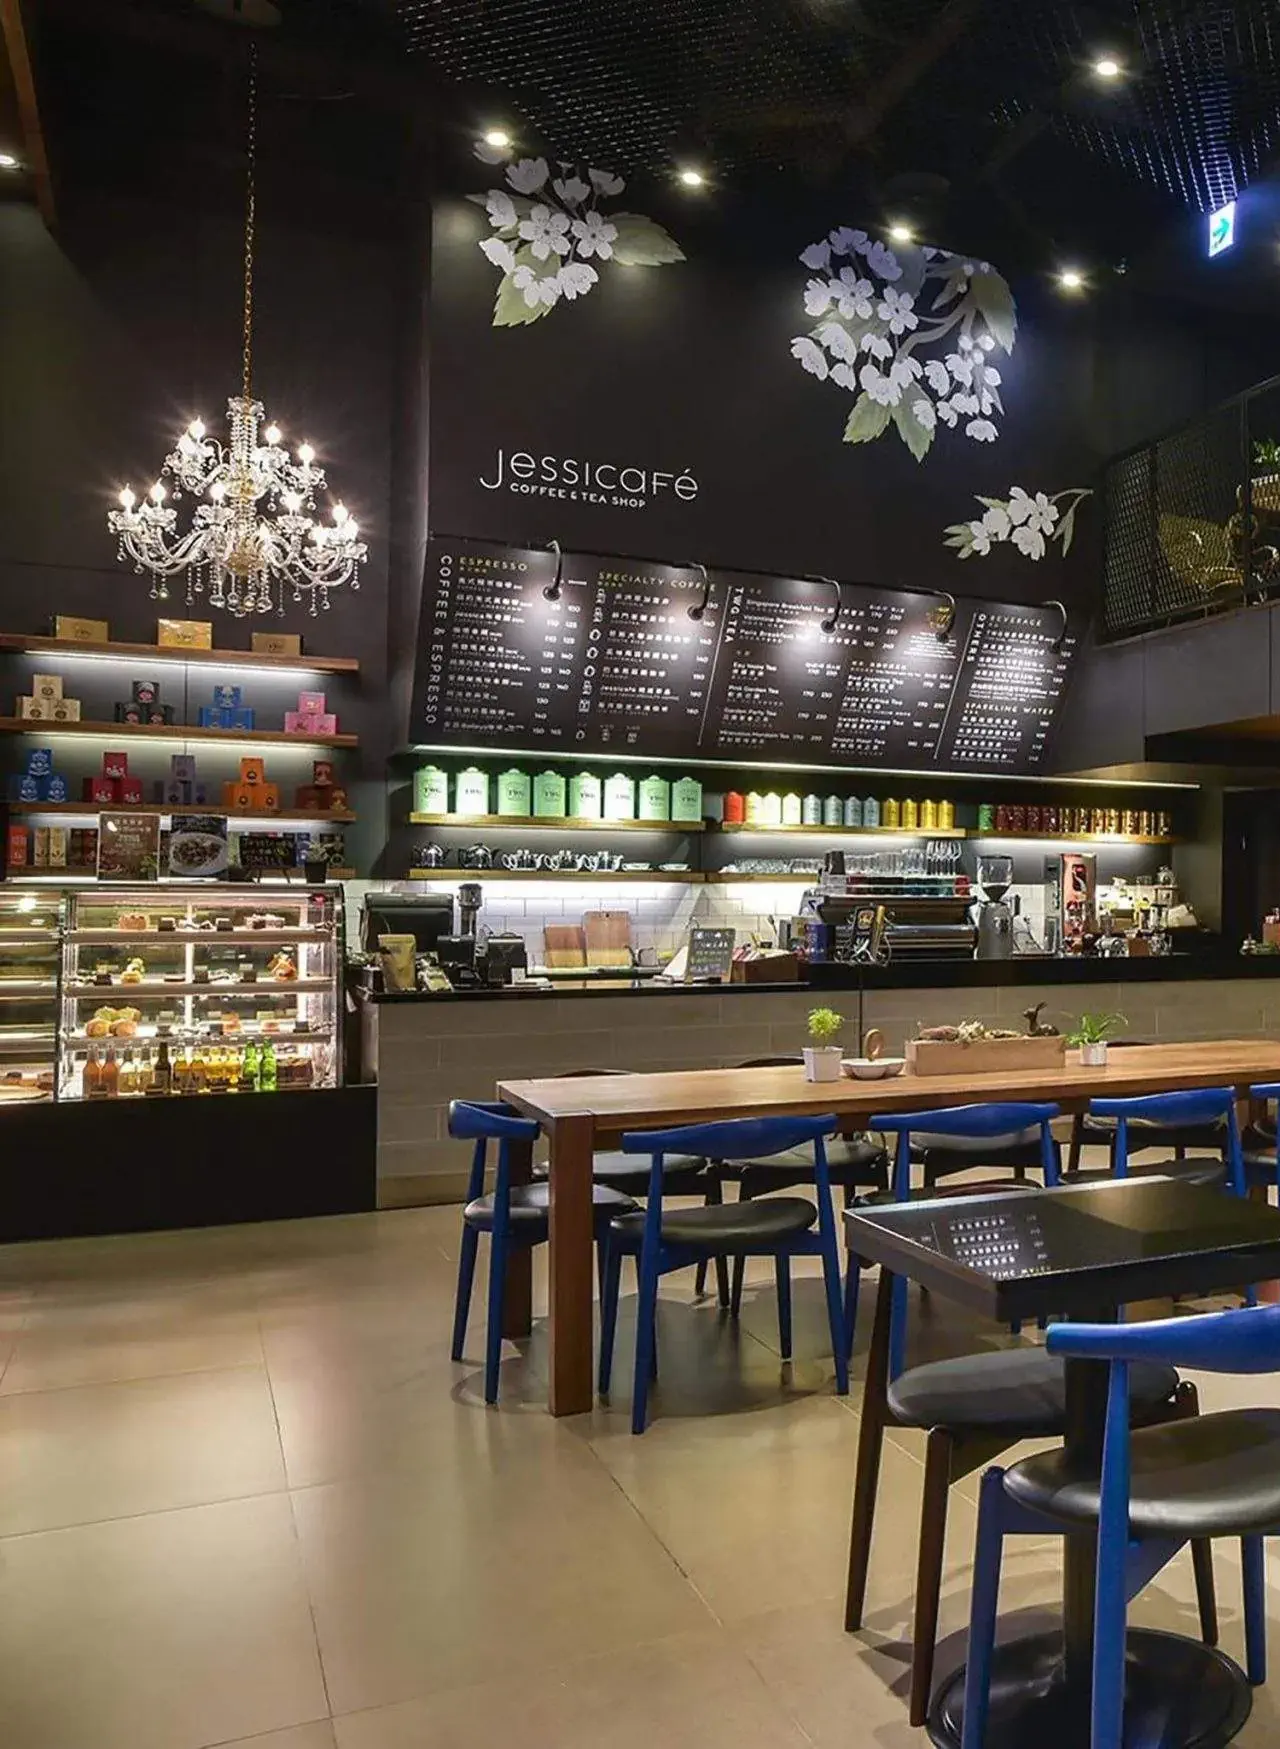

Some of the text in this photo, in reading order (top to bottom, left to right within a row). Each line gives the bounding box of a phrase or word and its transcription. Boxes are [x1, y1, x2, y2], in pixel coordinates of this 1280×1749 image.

[510, 482, 567, 499] COFFEE
[581, 491, 607, 505] TEA
[611, 495, 647, 508] SHOP
[459, 557, 528, 572] ESPRESSO
[435, 555, 453, 619] COFFEE
[599, 572, 665, 586] SPECIALTY
[724, 586, 745, 643] TWG TEA
[990, 615, 1042, 627] BEVERAGE
[966, 613, 987, 662] OTHERS
[425, 644, 444, 724] ESPRESSO
[965, 702, 1054, 715] SPARKLING WATER
